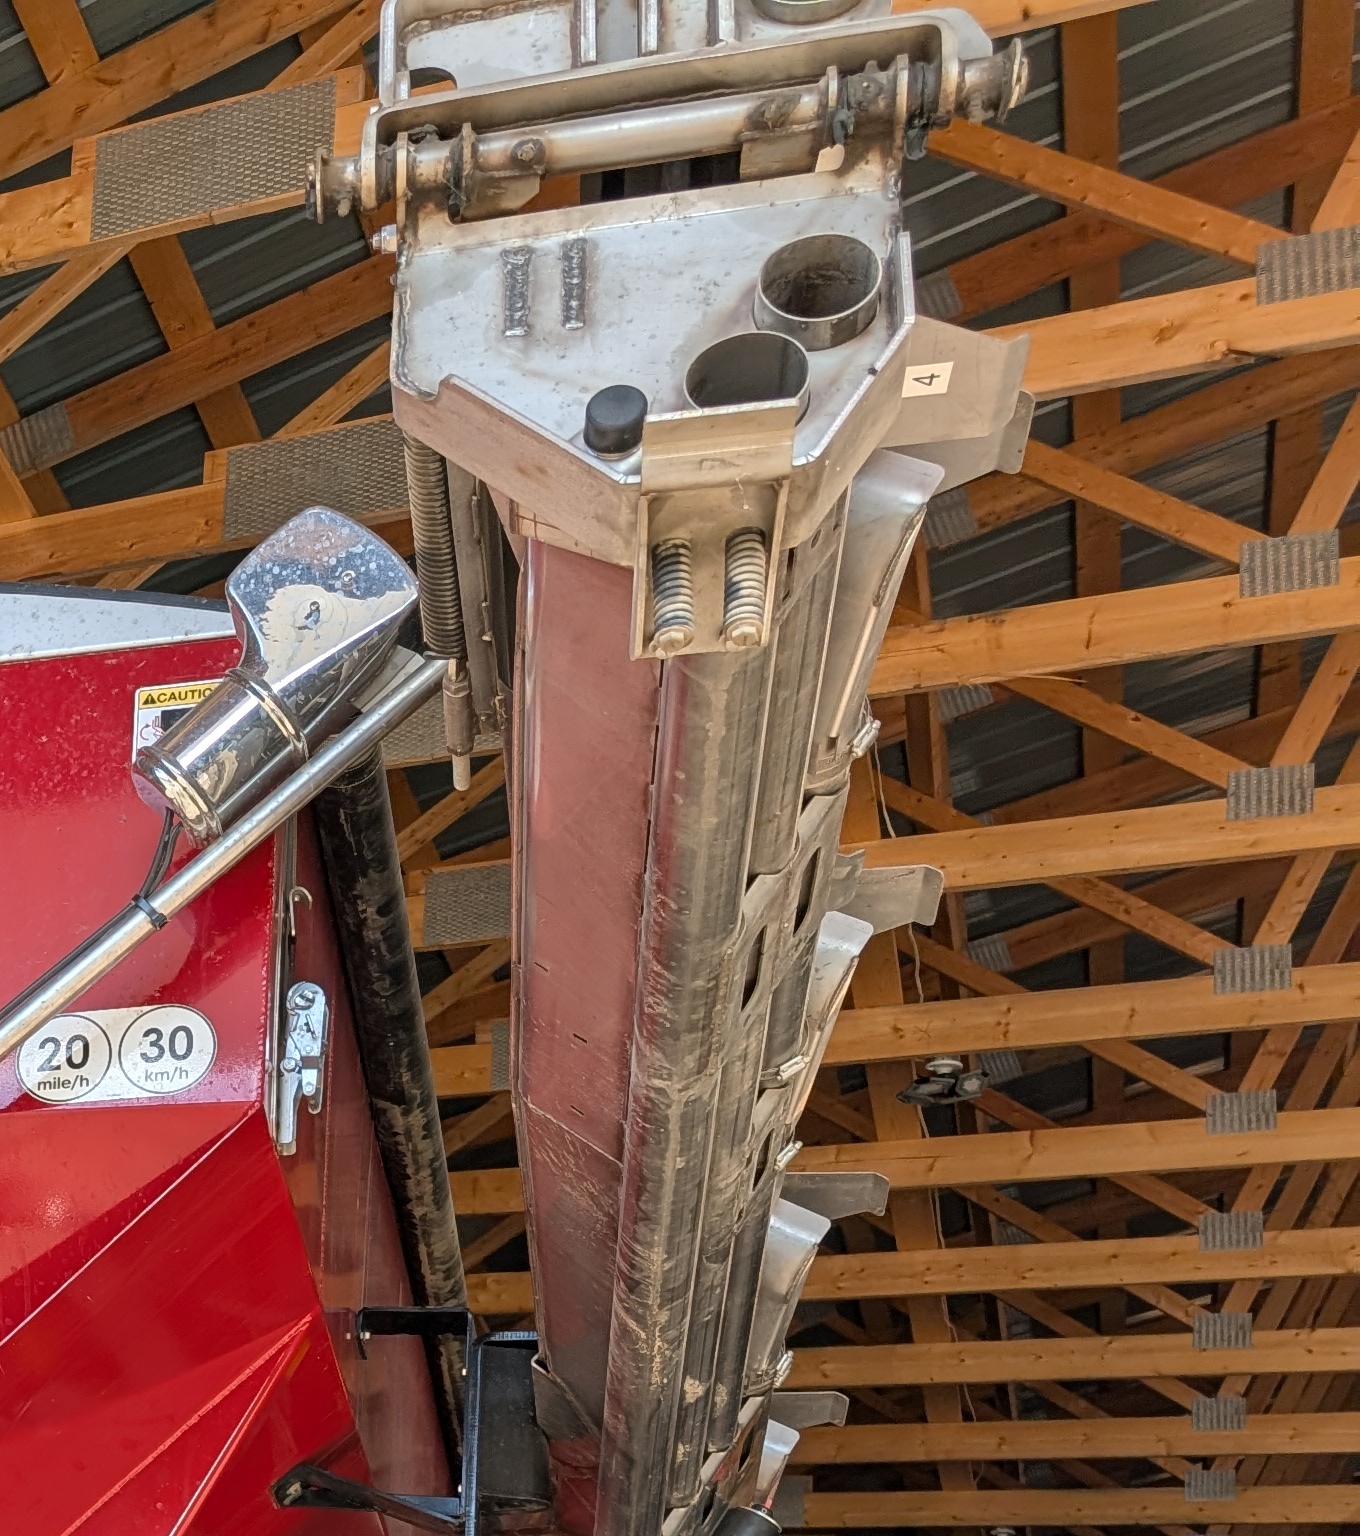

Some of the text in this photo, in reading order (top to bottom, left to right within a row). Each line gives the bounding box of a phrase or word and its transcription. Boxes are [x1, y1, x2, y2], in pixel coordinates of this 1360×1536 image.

[912, 373, 941, 386] 4
[156, 687, 214, 703] CAUTIO
[37, 1033, 90, 1073] 20
[139, 1025, 194, 1064] 30
[37, 1074, 90, 1092] mile/h
[144, 1066, 189, 1083] km/h
